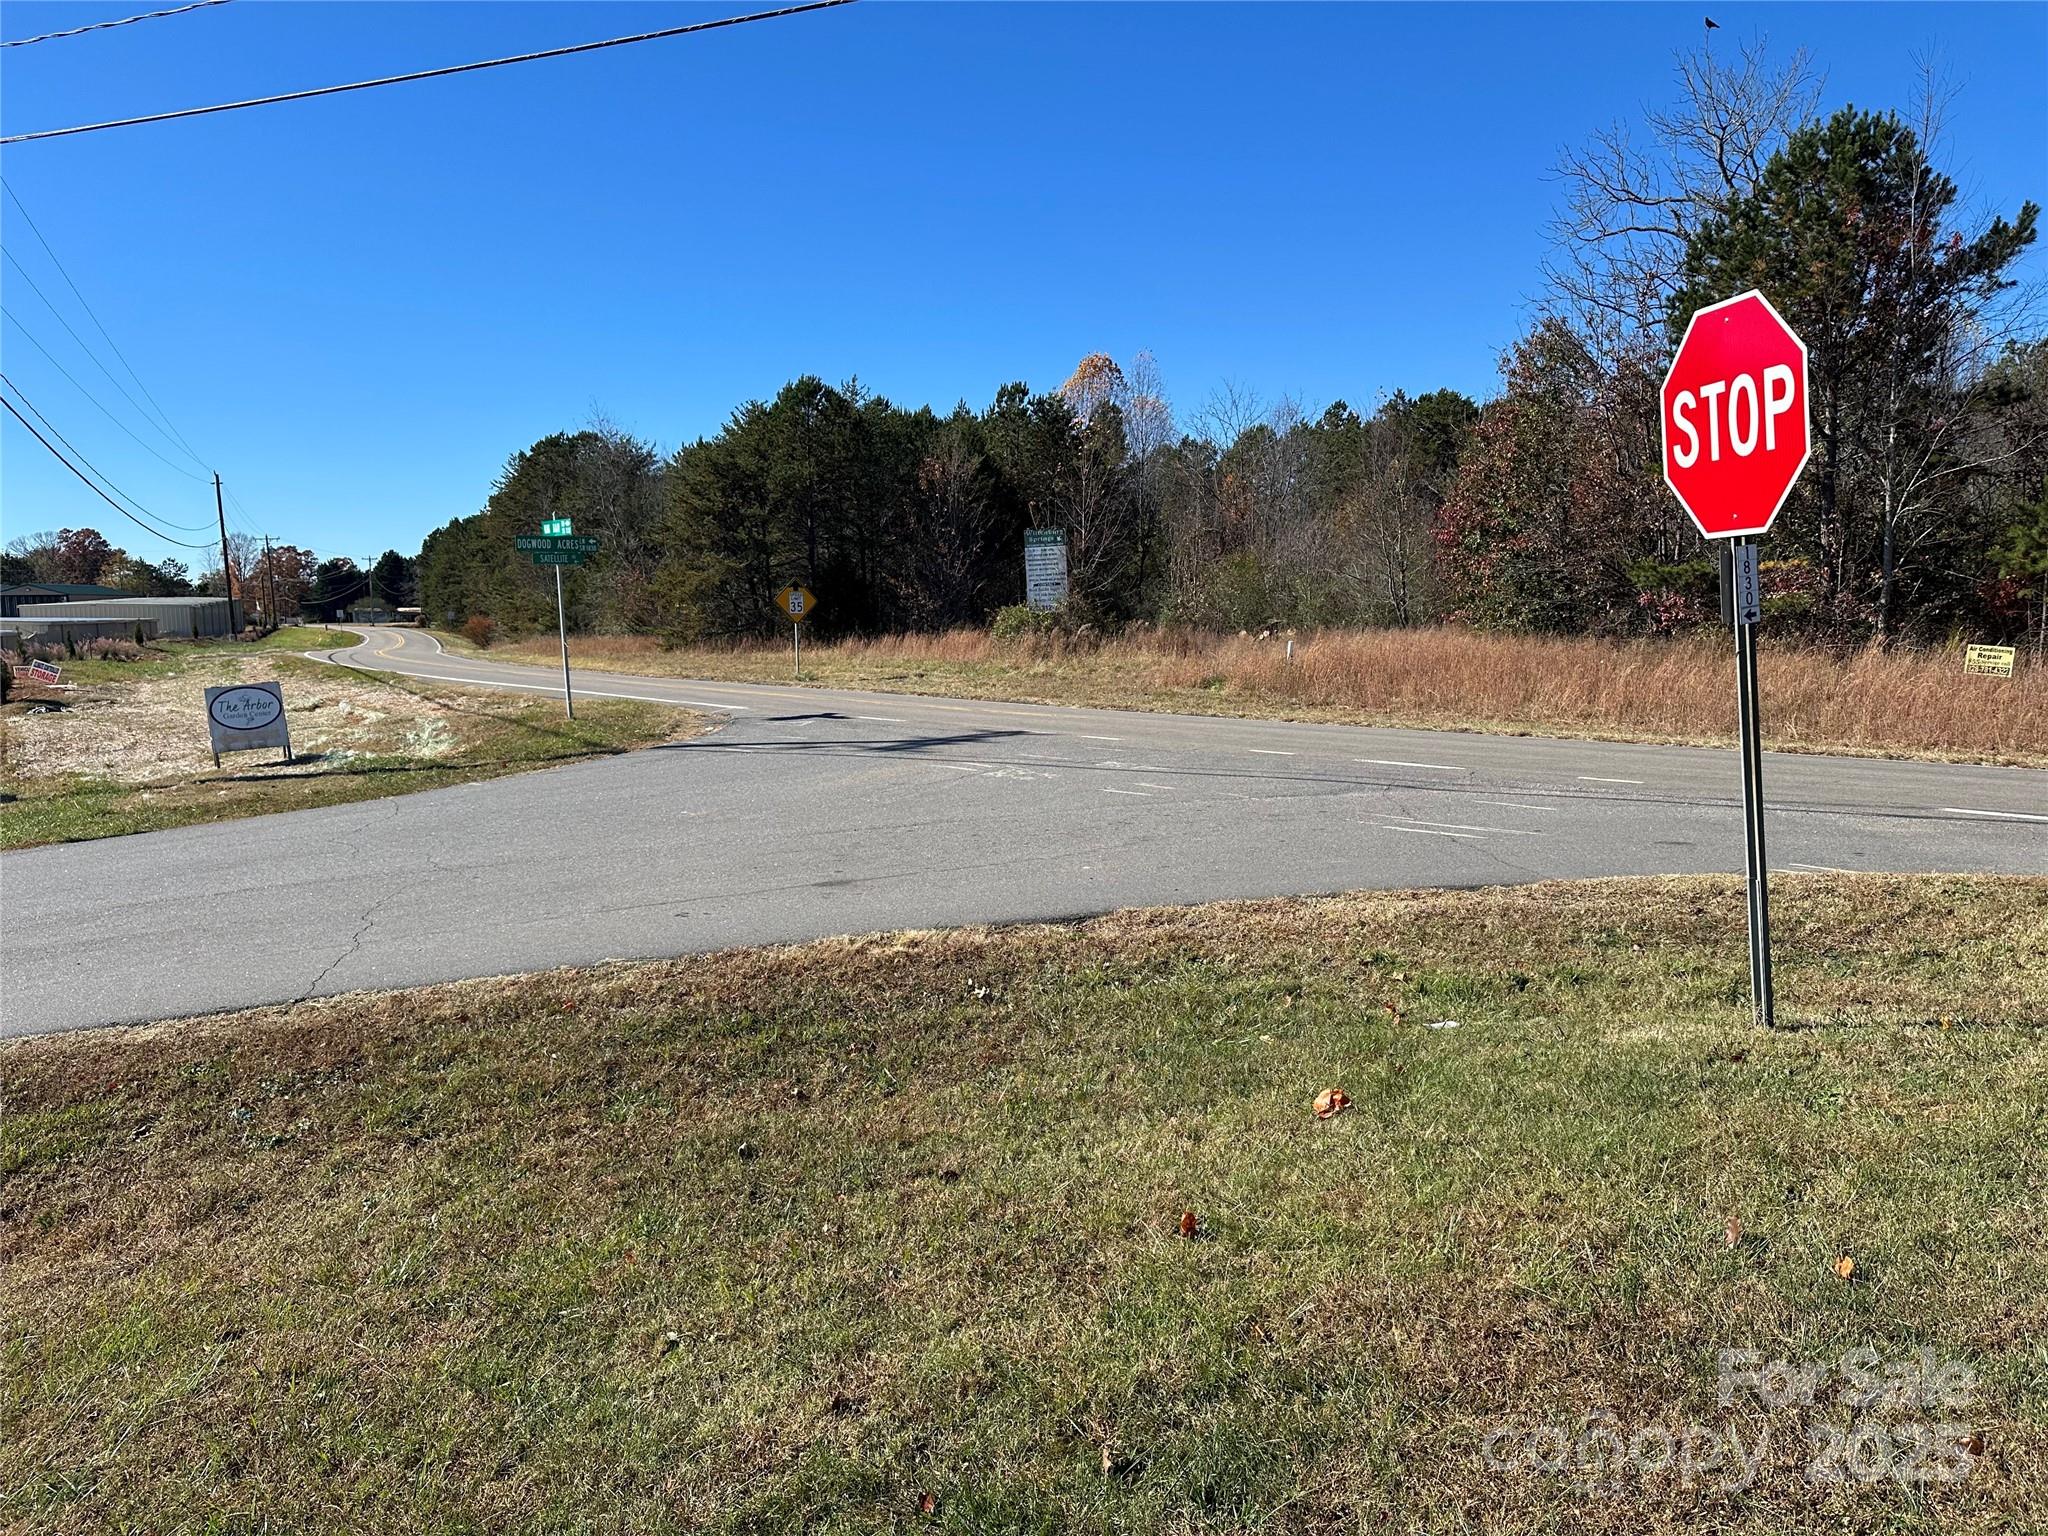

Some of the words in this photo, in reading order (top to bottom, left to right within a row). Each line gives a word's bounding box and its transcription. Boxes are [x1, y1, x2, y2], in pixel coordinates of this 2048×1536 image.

[1672, 363, 1796, 469] STOP
[517, 538, 552, 549] DOGWOOD
[557, 539, 579, 550] ACRES
[540, 554, 569, 563] SATELLITE
[1743, 546, 1754, 606] 1830
[790, 601, 803, 612] 35
[1977, 652, 2003, 660] Repair
[1978, 646, 2013, 655] Conditioning
[31, 669, 57, 683] STORAGE
[218, 700, 240, 713] The
[243, 699, 274, 712] Arbor
[222, 712, 248, 720] Garden
